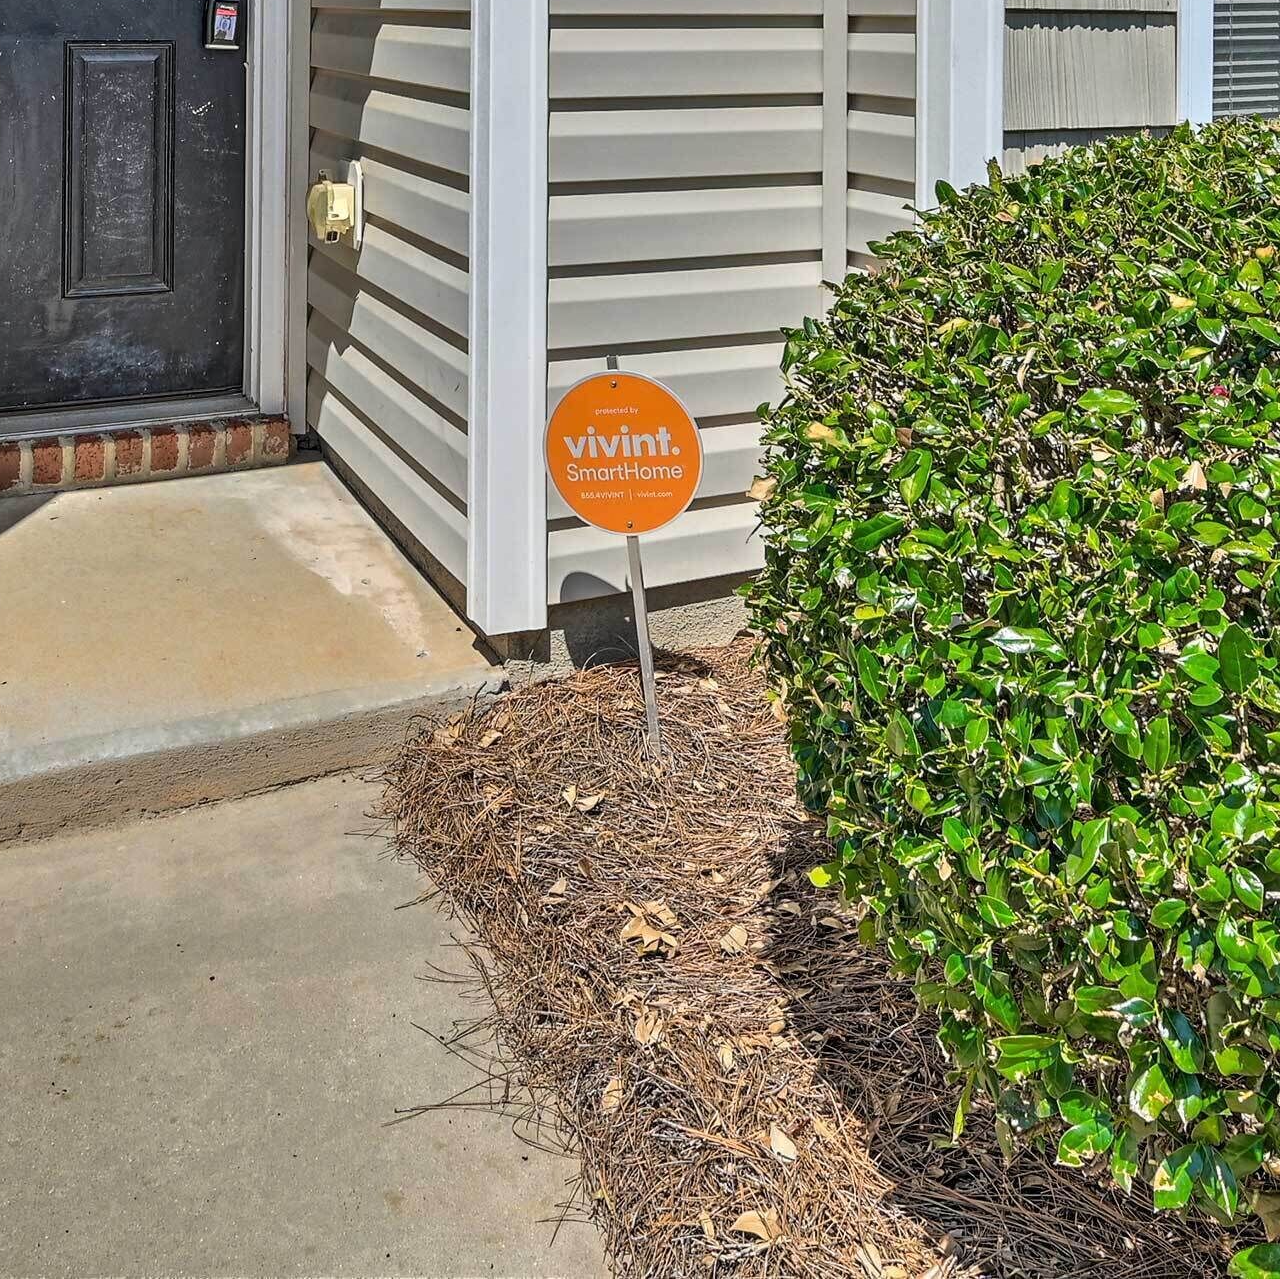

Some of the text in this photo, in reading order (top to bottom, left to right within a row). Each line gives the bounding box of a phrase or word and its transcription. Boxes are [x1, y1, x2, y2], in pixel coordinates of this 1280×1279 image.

[595, 406, 639, 416] protected by
[563, 425, 681, 459] vivint.
[566, 462, 683, 482] SmartHome
[637, 490, 673, 498] vivint.com
